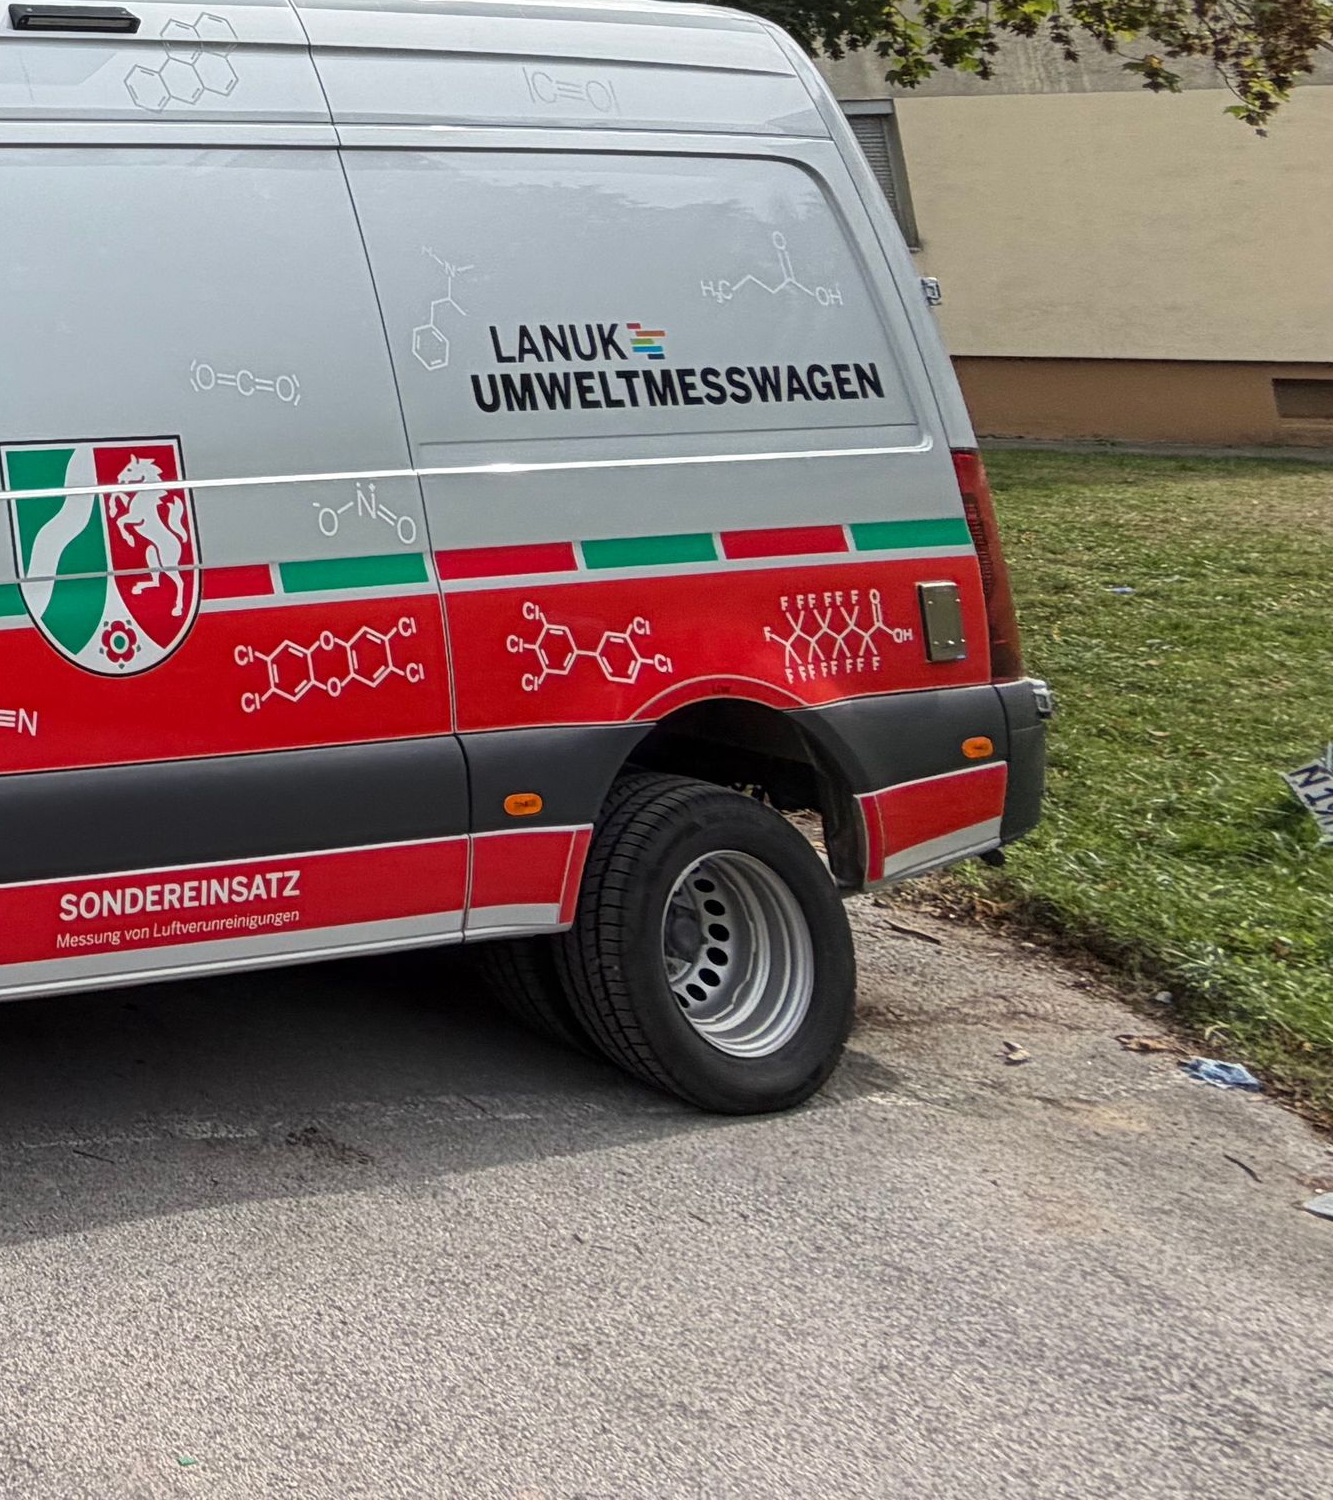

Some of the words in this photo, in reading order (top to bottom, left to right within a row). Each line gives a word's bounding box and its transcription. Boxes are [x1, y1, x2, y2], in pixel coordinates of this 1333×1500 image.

[489, 323, 628, 364] LANUK
[470, 362, 885, 413] UMWELTMESSWAGEN
[59, 870, 301, 922] SONDEREINSATZ
[56, 930, 121, 949] Messung
[124, 925, 150, 941] von
[153, 910, 300, 938] Luftverunreinigungen
